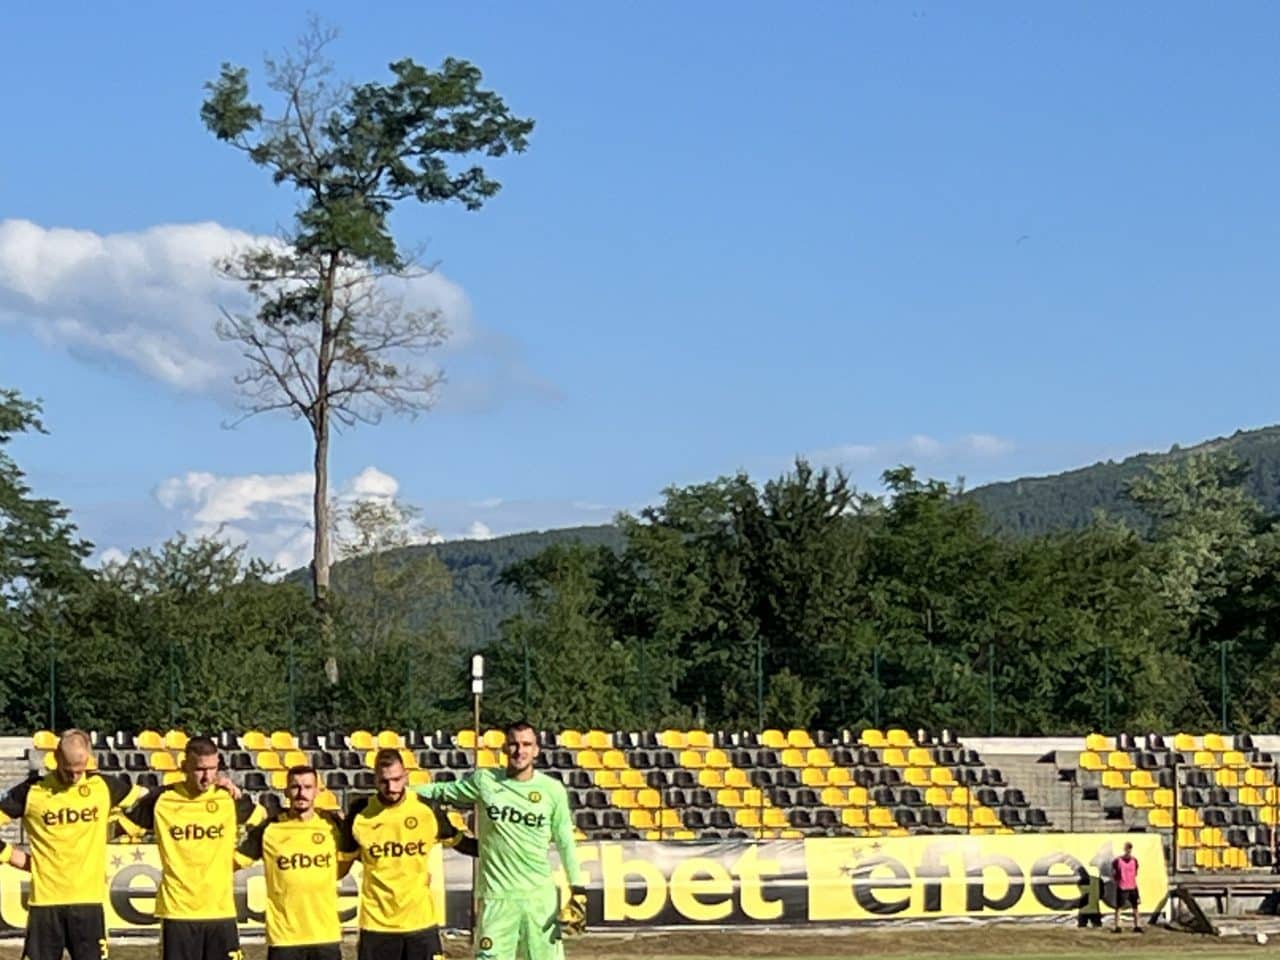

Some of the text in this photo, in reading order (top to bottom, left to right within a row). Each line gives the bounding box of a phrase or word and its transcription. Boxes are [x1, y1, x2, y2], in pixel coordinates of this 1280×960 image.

[43, 806, 100, 826] efbet
[486, 805, 547, 828] efbet
[169, 823, 225, 842] efbet
[368, 840, 428, 858] efbet
[276, 852, 333, 870] efbet
[851, 840, 1133, 915] efbet
